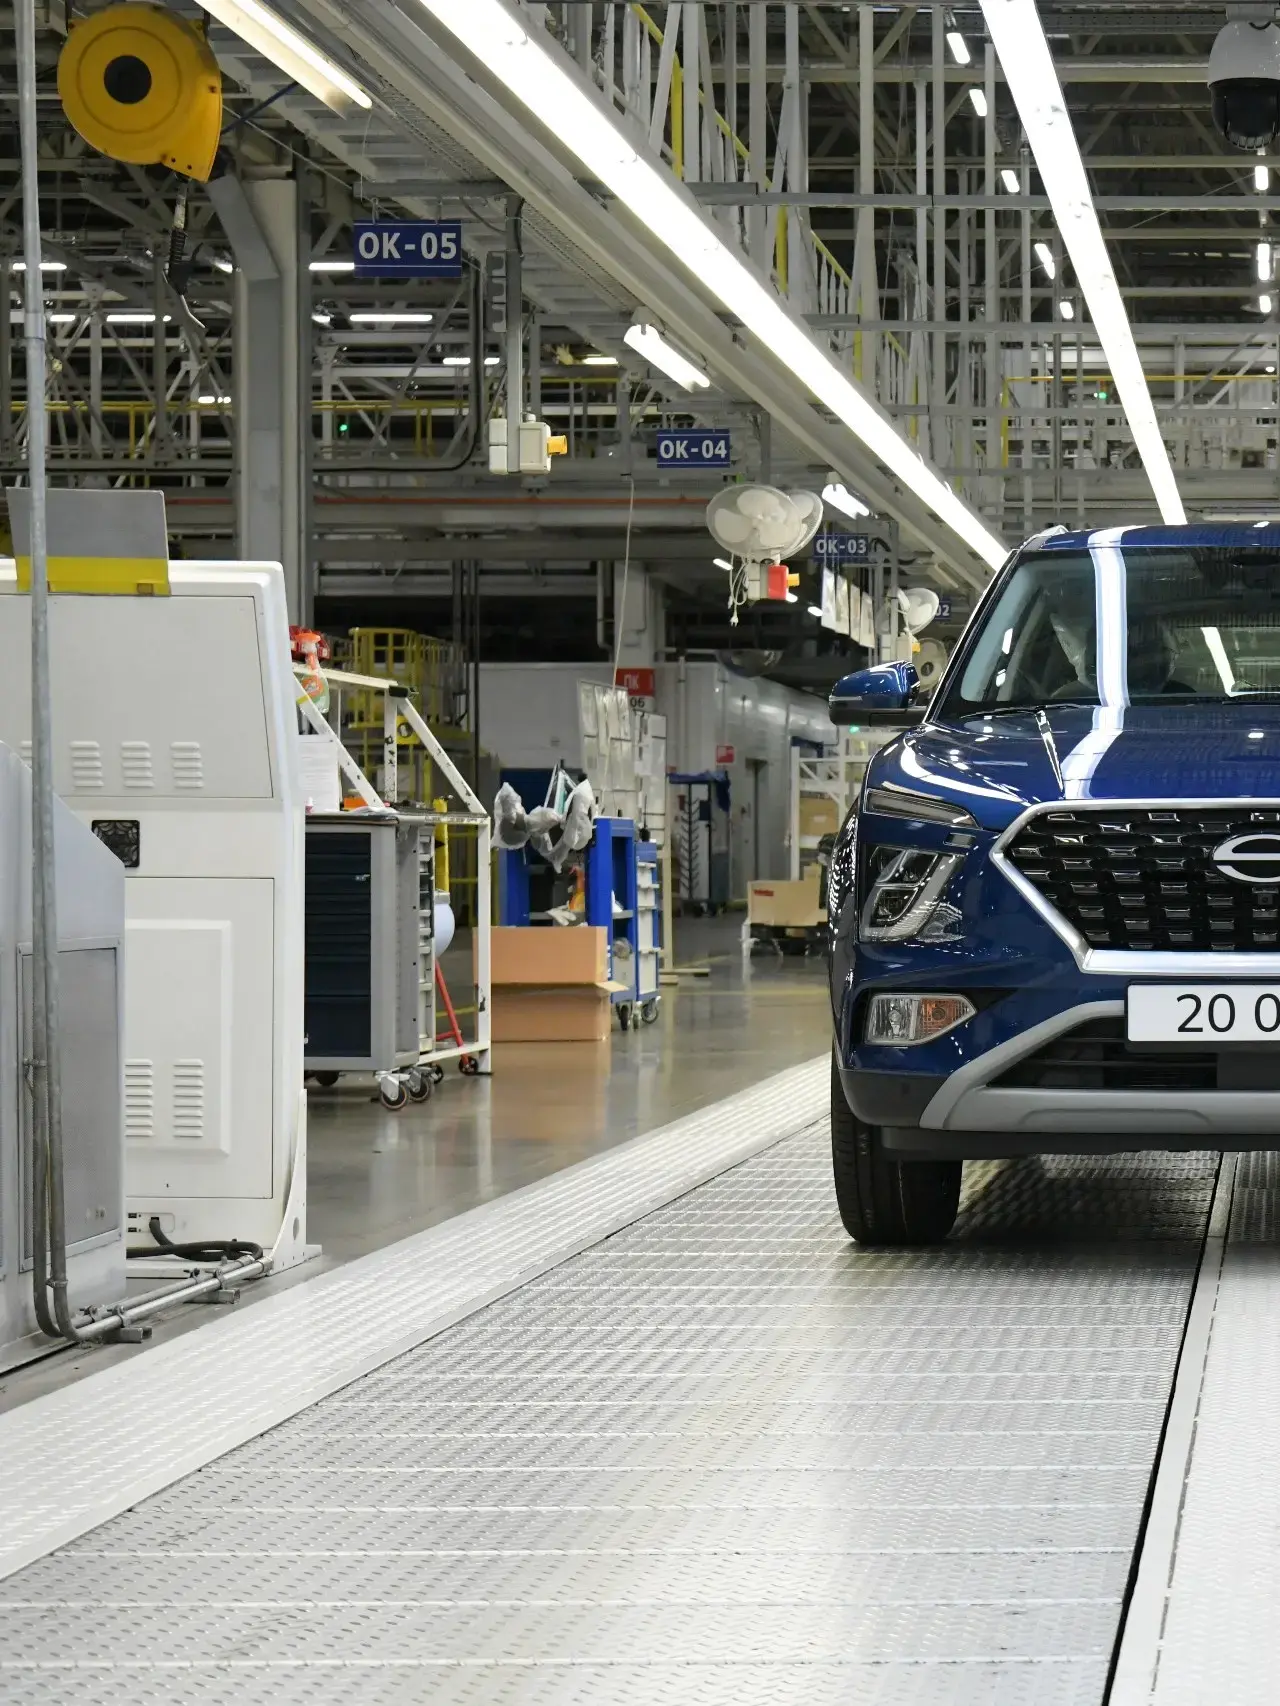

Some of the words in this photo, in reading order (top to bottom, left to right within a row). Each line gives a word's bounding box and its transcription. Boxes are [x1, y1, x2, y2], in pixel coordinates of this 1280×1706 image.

[358, 231, 457, 260] OK-05
[660, 439, 728, 459] OK-04
[815, 538, 867, 555] OK-03
[1176, 993, 1236, 1033] 20
